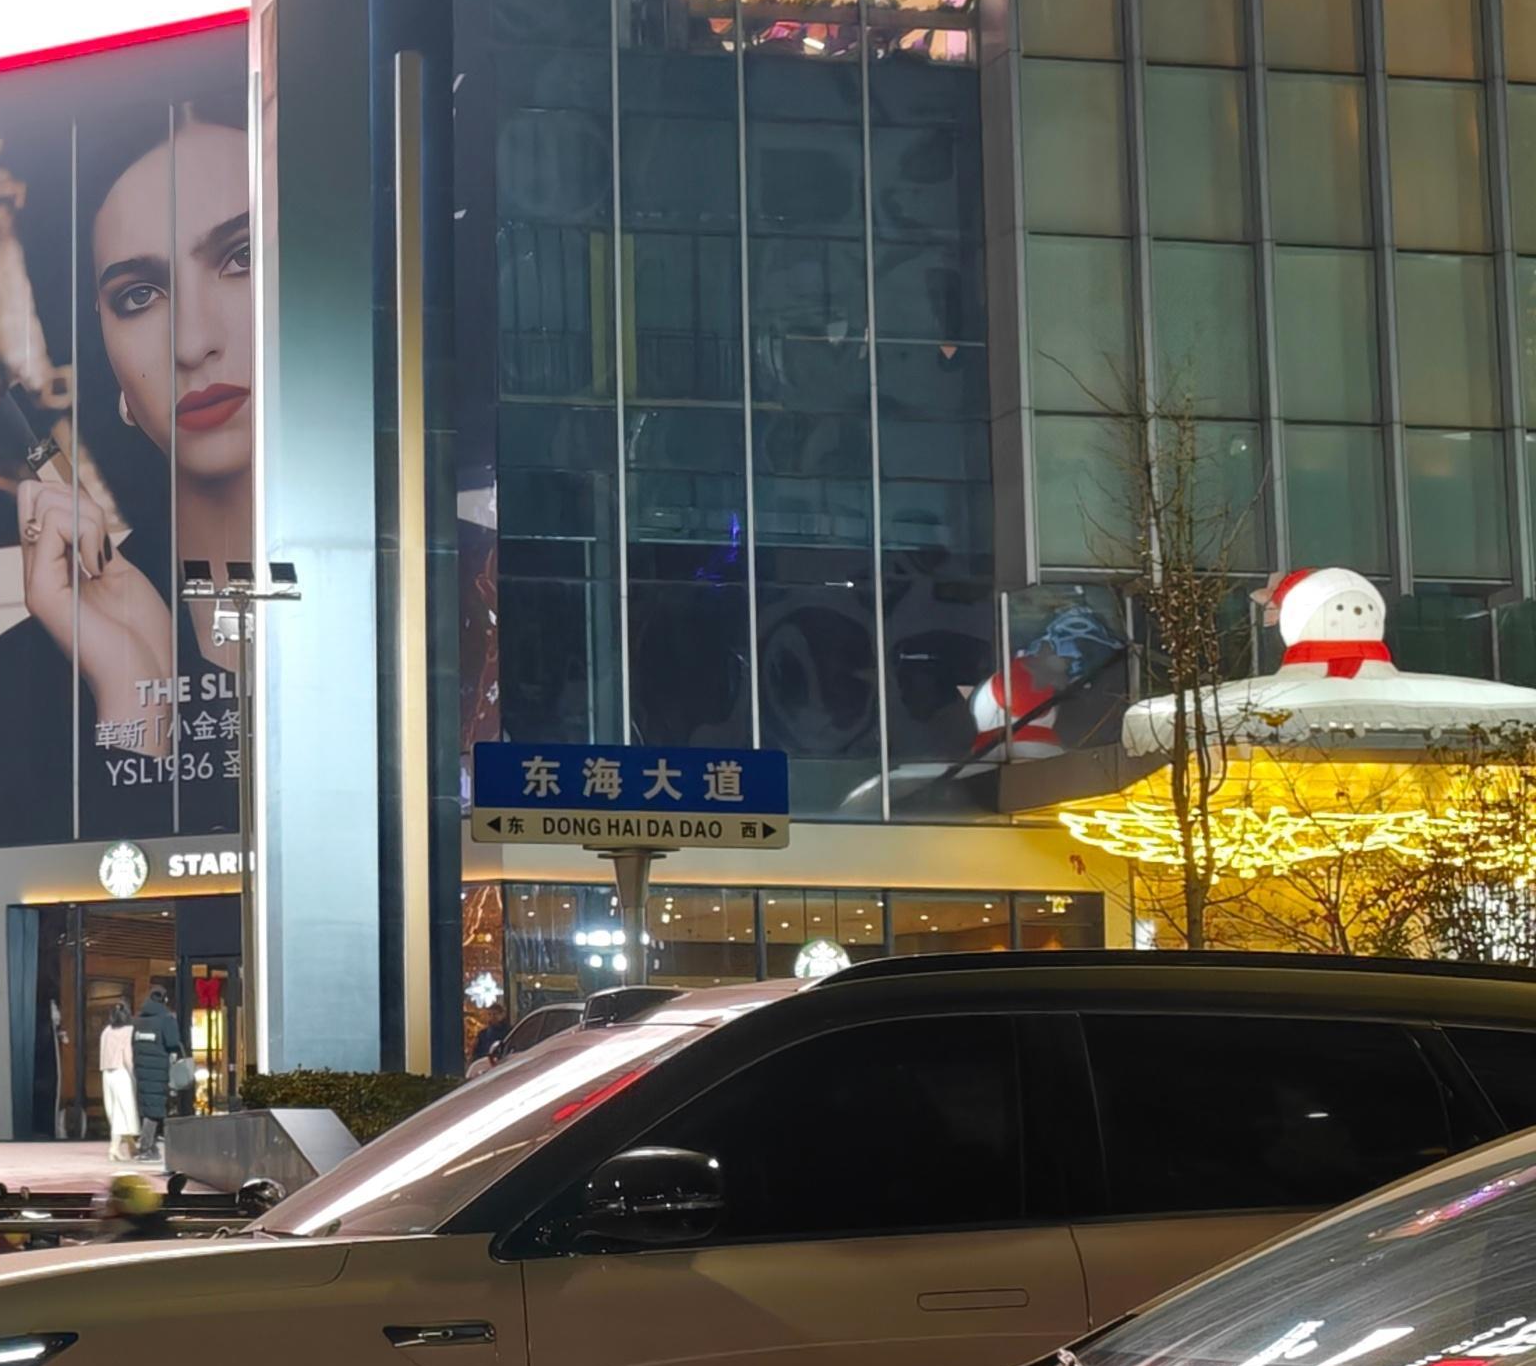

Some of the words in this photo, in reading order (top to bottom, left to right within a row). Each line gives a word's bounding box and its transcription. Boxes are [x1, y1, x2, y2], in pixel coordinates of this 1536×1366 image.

[135, 675, 191, 708] THE
[106, 751, 214, 787] YSL1936
[521, 755, 745, 803] 东海大道
[507, 816, 525, 834] 东
[543, 816, 602, 836] DONG
[607, 818, 641, 837] HAI
[648, 819, 675, 837] DA
[680, 820, 723, 840] DAO
[740, 821, 758, 840] 西
